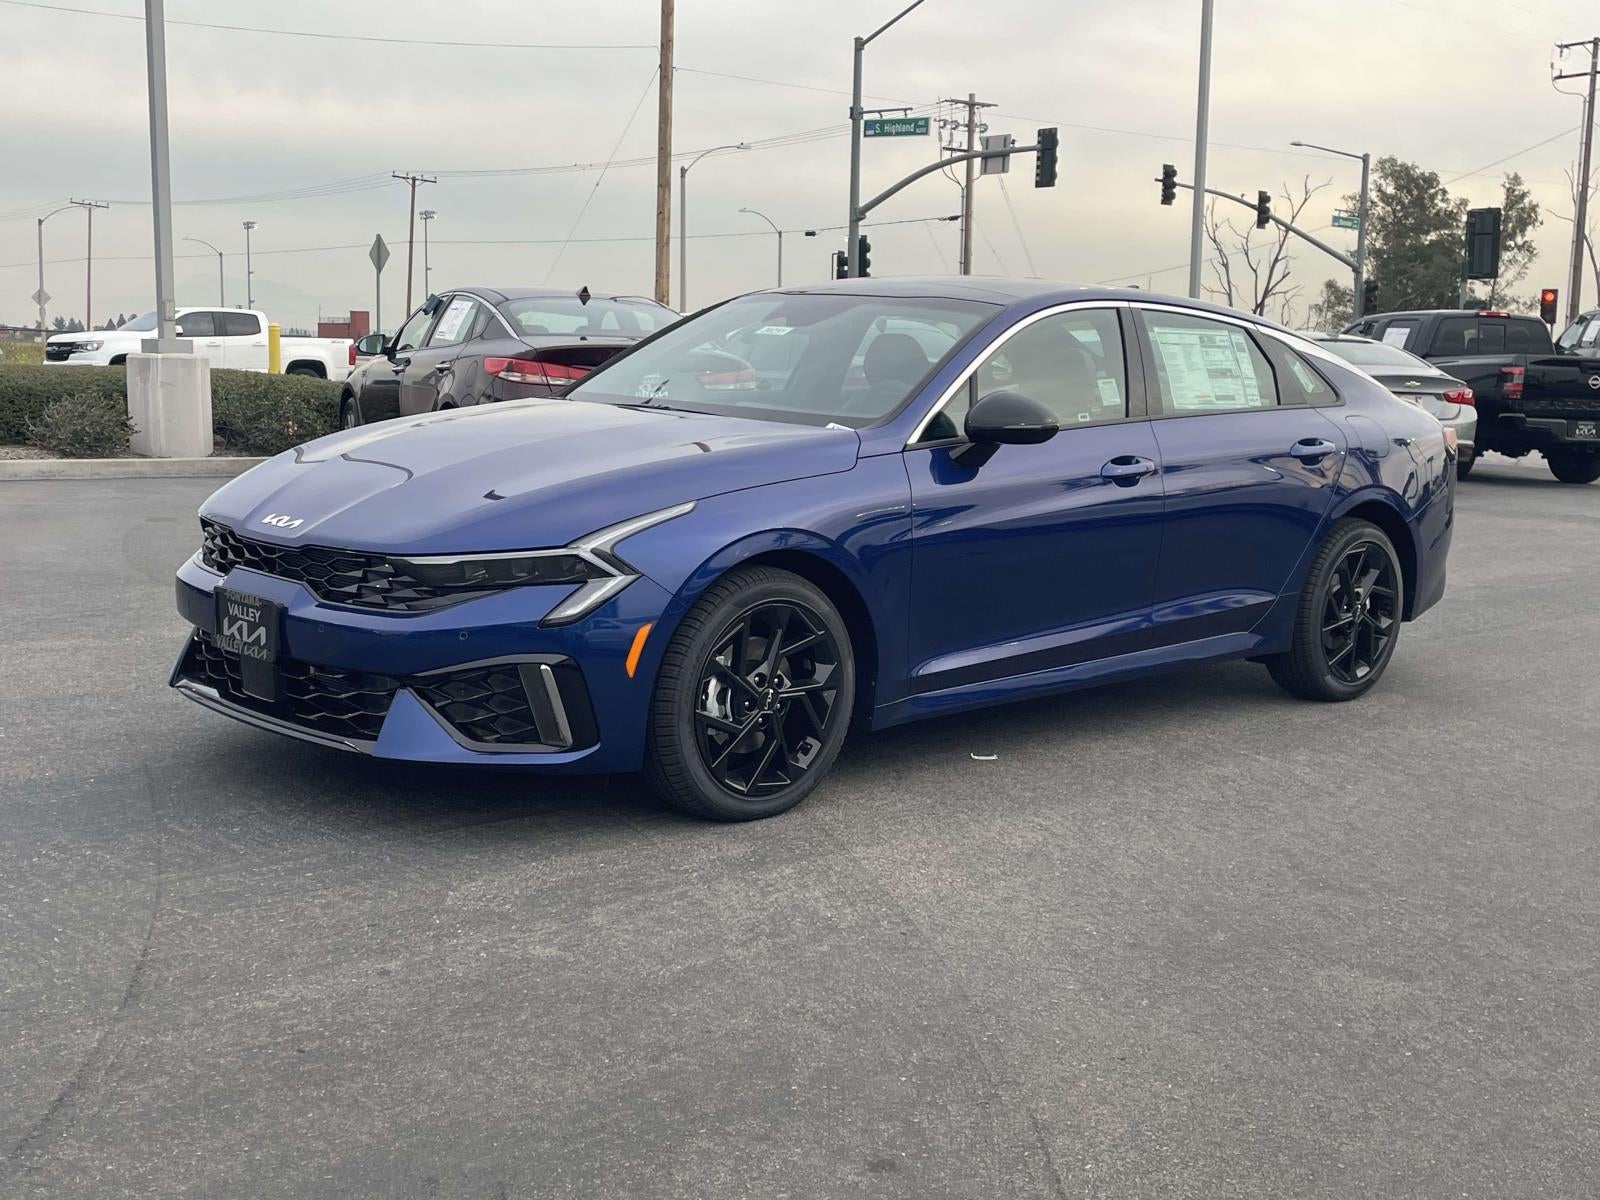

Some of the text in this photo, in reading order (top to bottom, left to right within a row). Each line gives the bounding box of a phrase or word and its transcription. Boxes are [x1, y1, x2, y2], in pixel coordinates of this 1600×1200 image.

[884, 122, 915, 136] Highland
[262, 513, 304, 529] KIA
[227, 601, 261, 623] VALLEY
[223, 616, 267, 646] KIA
[216, 633, 244, 655] VALLEY
